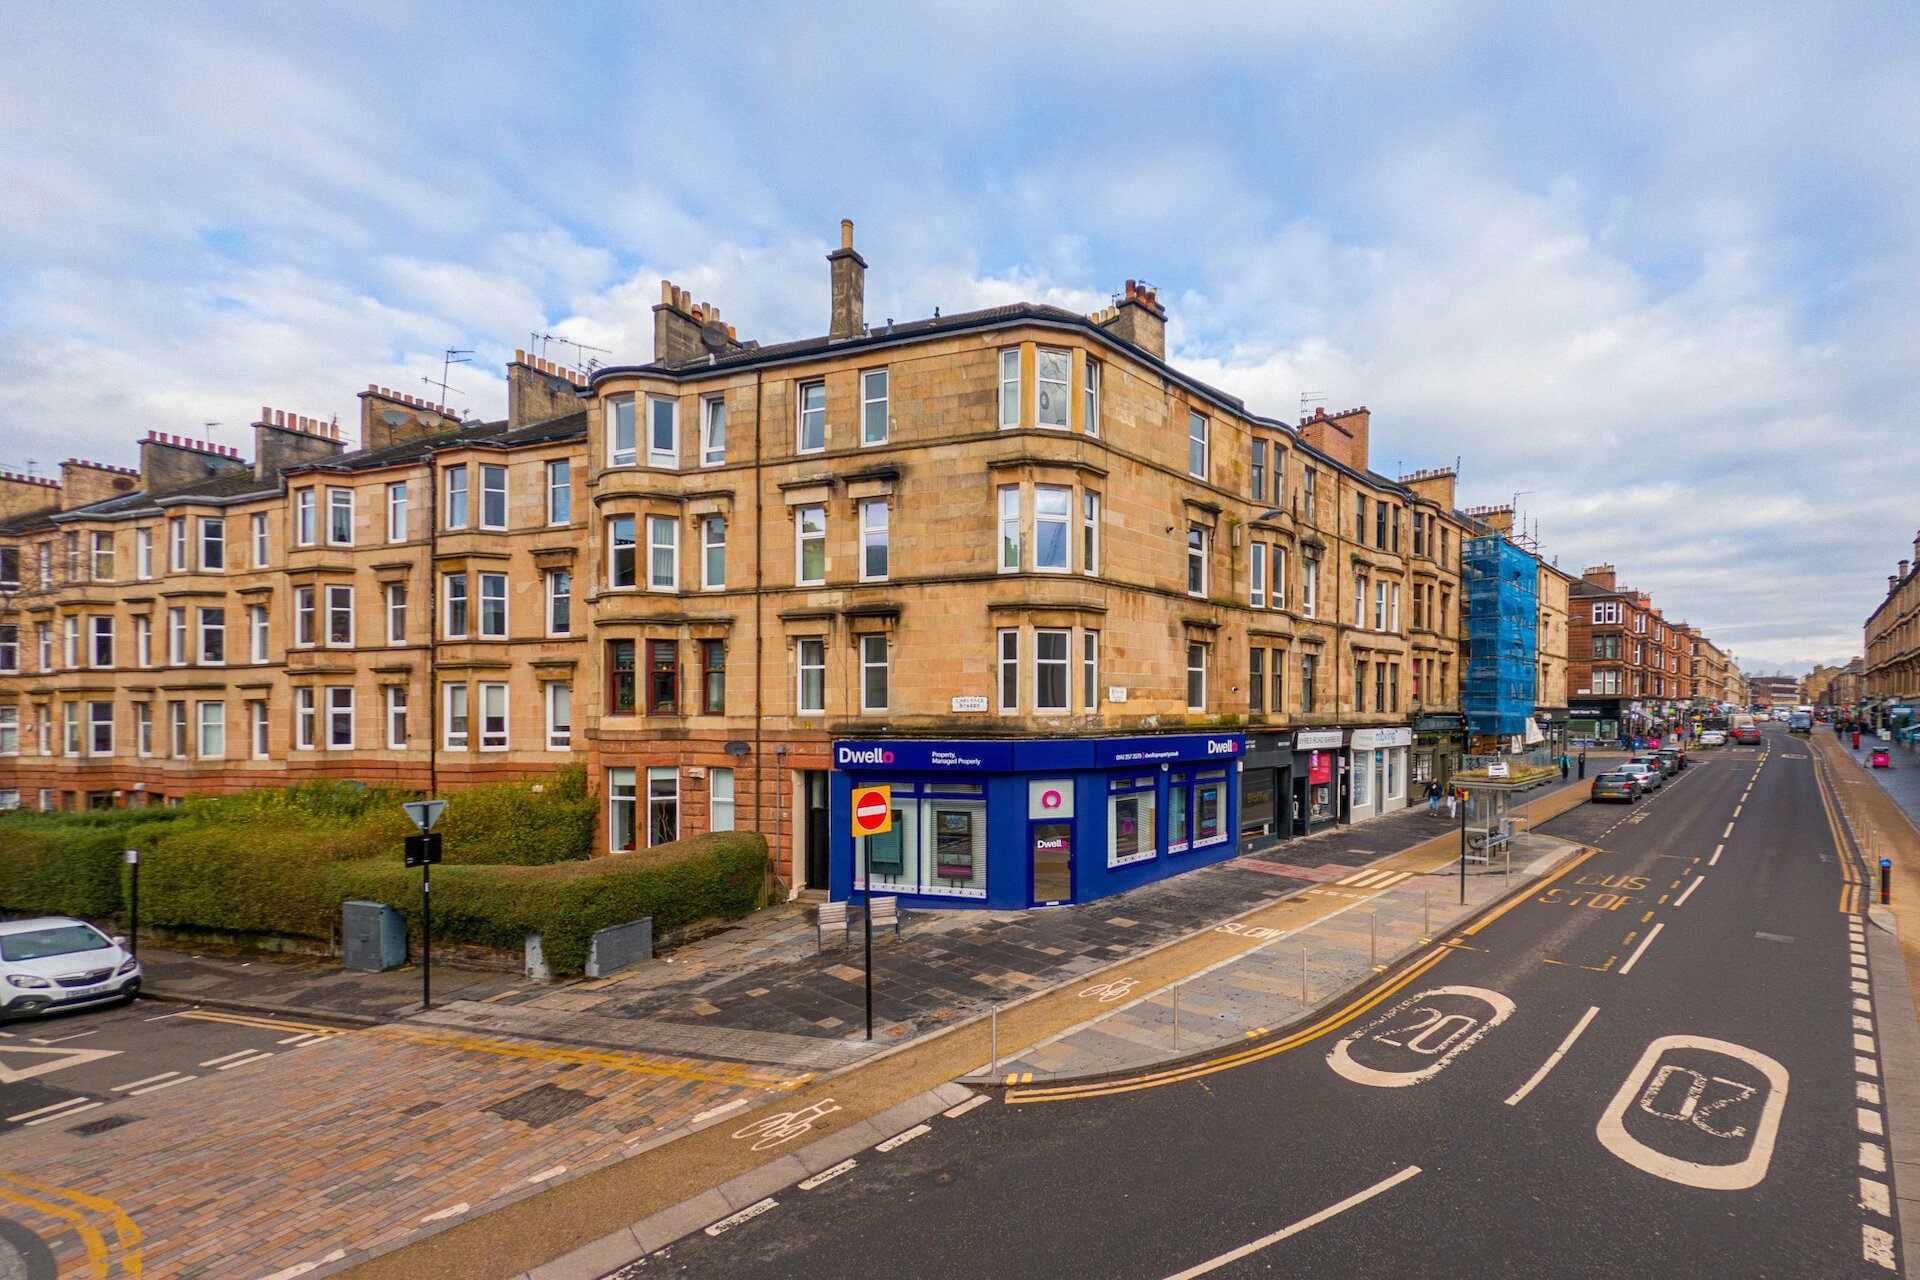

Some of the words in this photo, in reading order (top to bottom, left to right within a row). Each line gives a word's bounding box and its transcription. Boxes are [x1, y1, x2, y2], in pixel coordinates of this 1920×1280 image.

[839, 747, 894, 764] Dwello
[1208, 740, 1239, 754] Dwello
[931, 757, 958, 766] Managed
[1037, 839, 1068, 849] Dwello
[1575, 873, 1652, 890] BUS
[1214, 923, 1286, 940] SLOW
[1372, 1007, 1478, 1054] 20
[1640, 1065, 1757, 1138] 20
